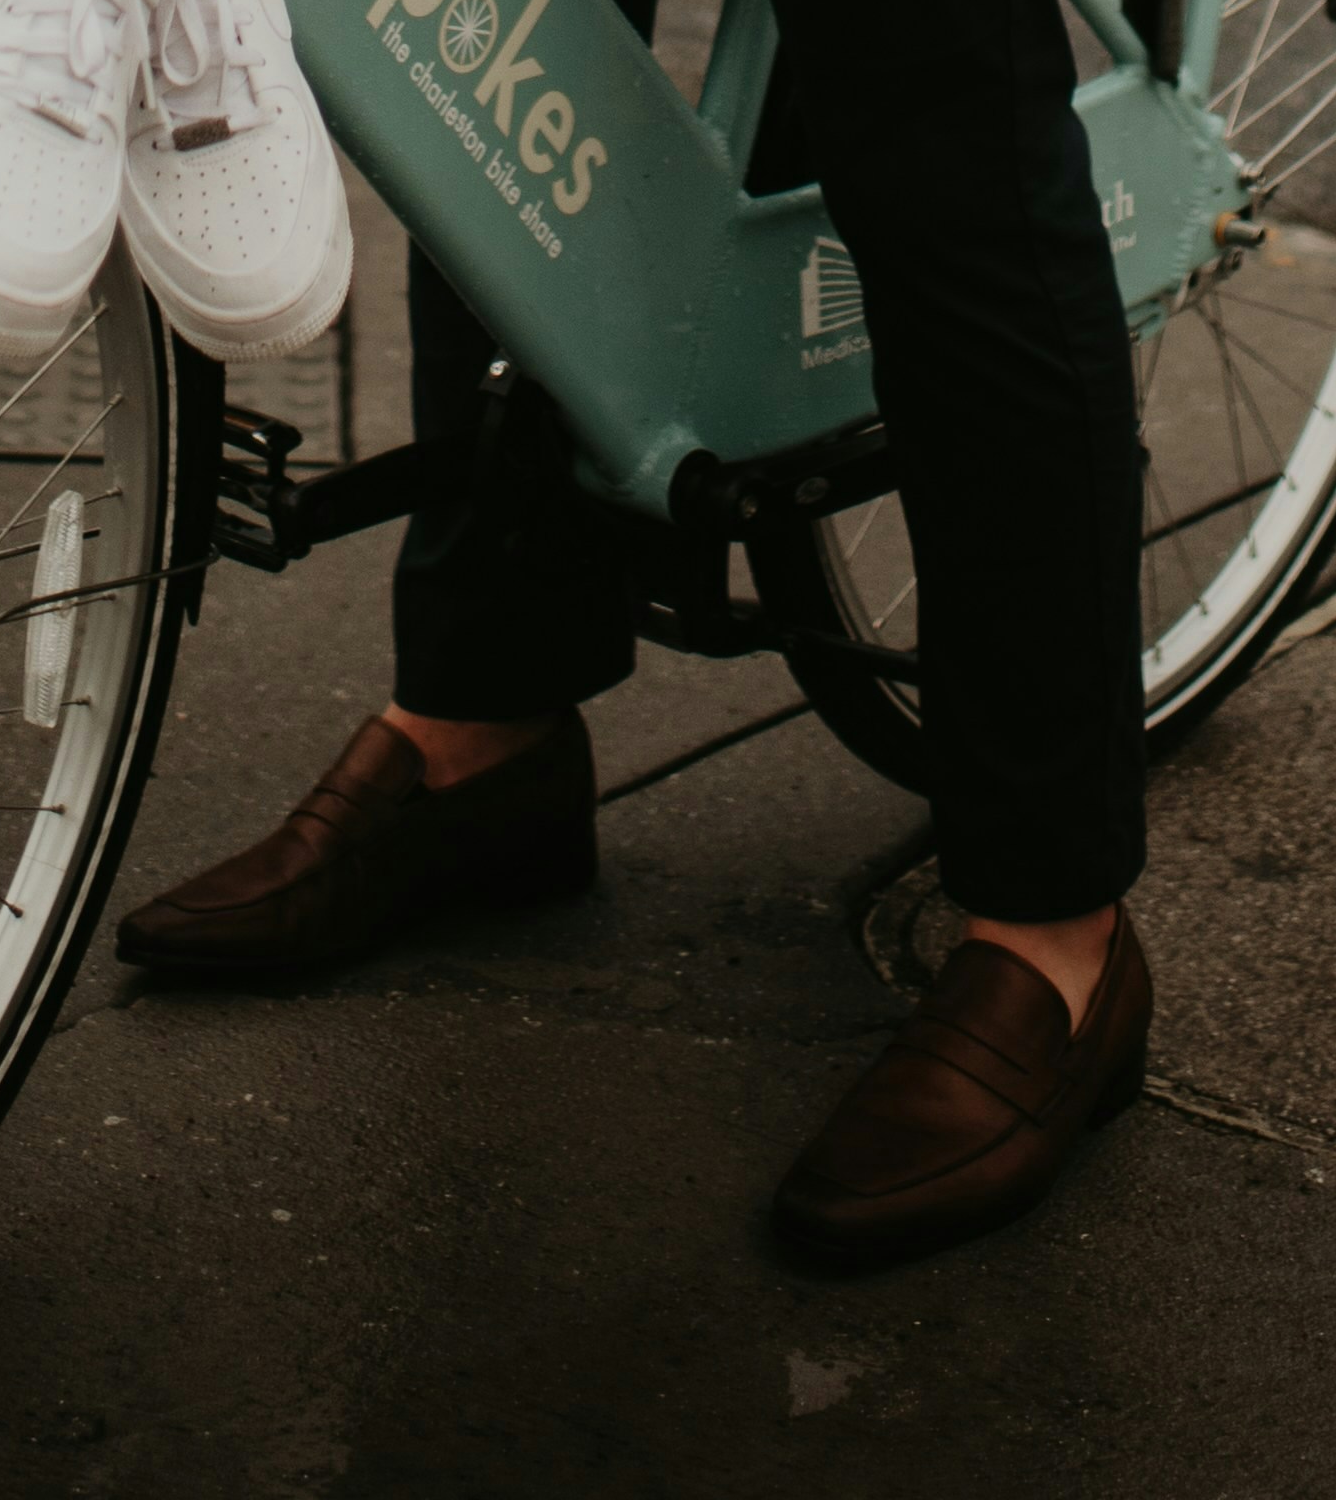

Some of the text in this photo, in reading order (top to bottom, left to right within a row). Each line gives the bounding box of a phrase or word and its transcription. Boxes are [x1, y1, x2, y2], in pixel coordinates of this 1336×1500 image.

[381, 21, 563, 259] the charleston bike share
